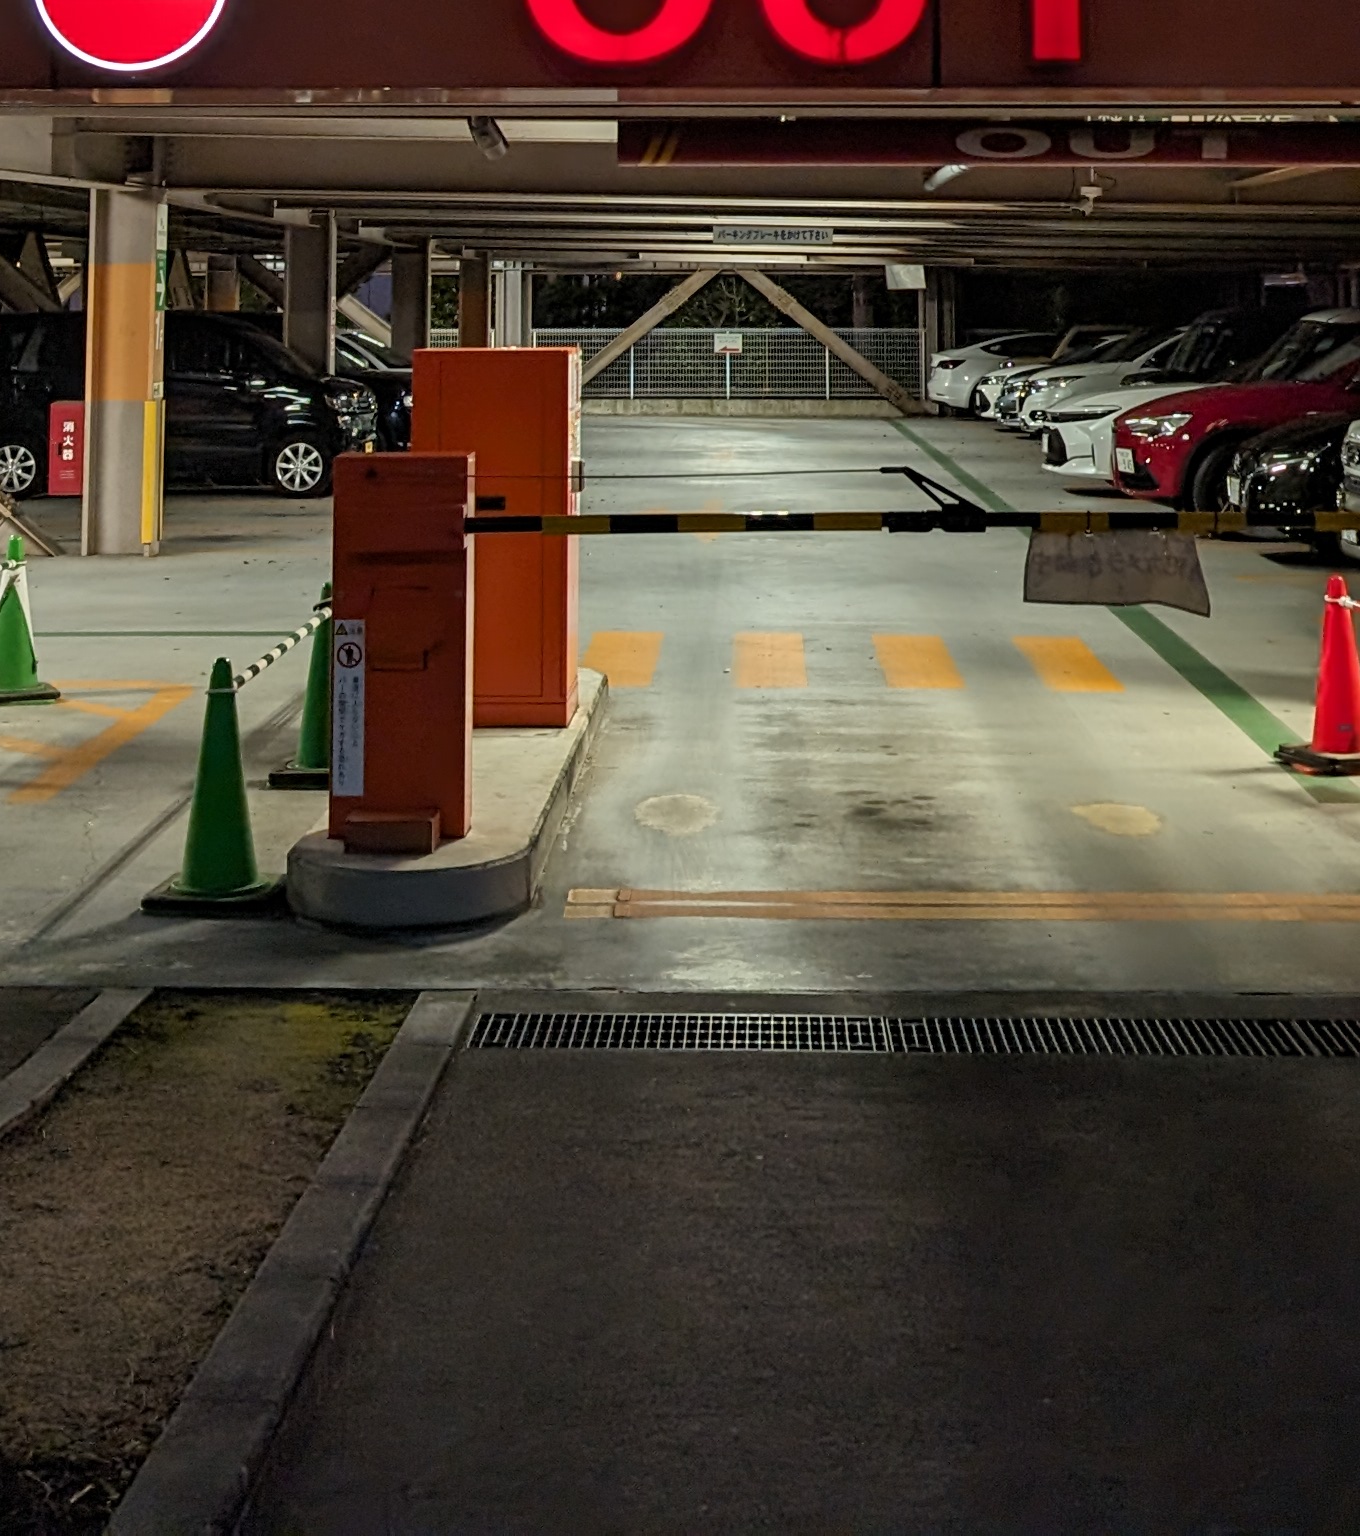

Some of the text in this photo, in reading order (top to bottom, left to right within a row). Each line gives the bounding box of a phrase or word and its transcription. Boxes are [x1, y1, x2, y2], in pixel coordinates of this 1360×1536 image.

[717, 229, 829, 241] パーキングブレーキをかけて下さい
[62, 421, 75, 461] 消火器
